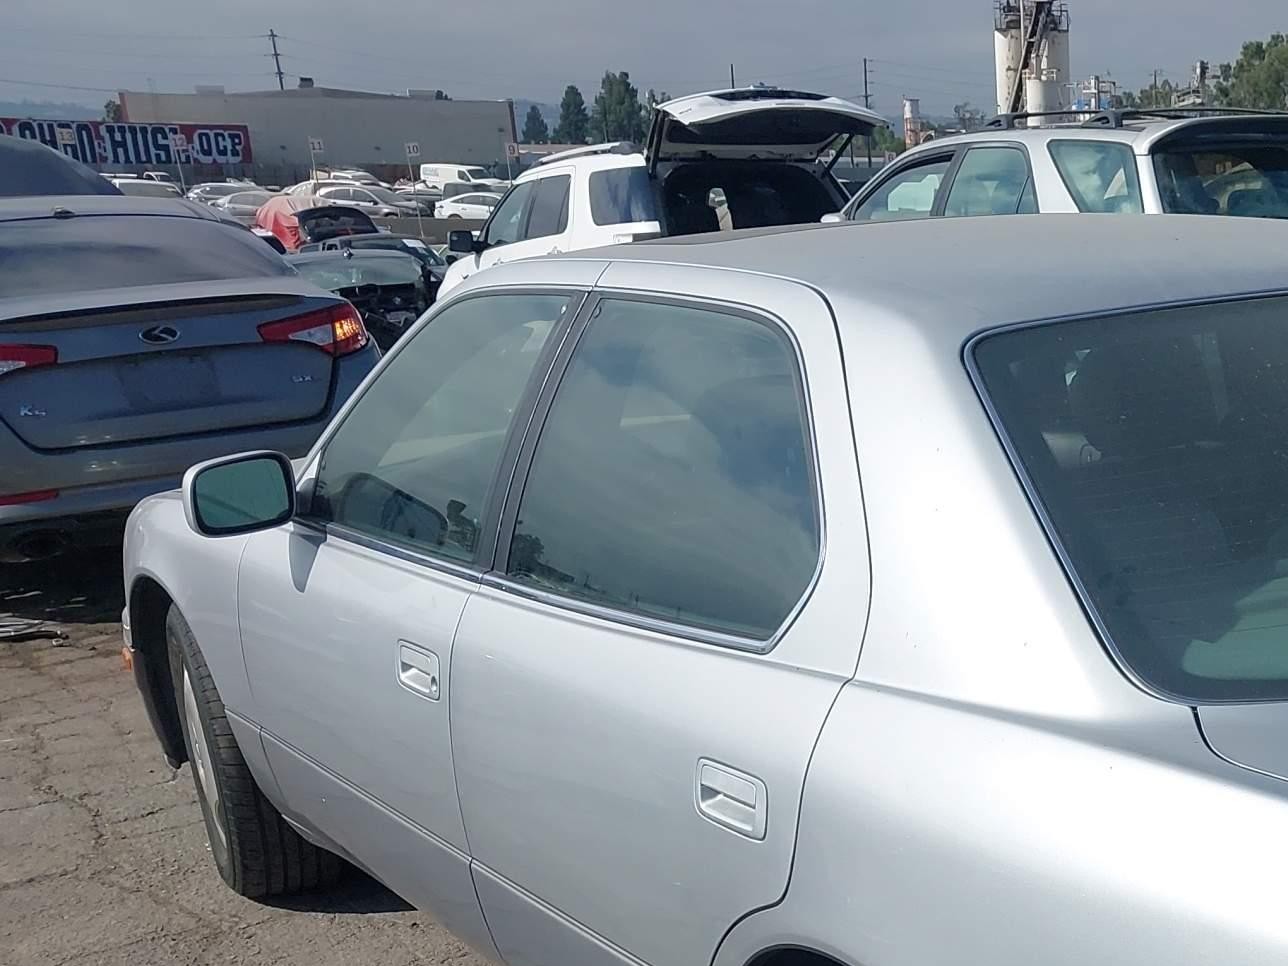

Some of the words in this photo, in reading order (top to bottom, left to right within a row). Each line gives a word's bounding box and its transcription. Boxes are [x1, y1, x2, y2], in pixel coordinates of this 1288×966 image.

[310, 141, 323, 151] 11
[407, 145, 419, 154] 10
[508, 146, 516, 155] 9
